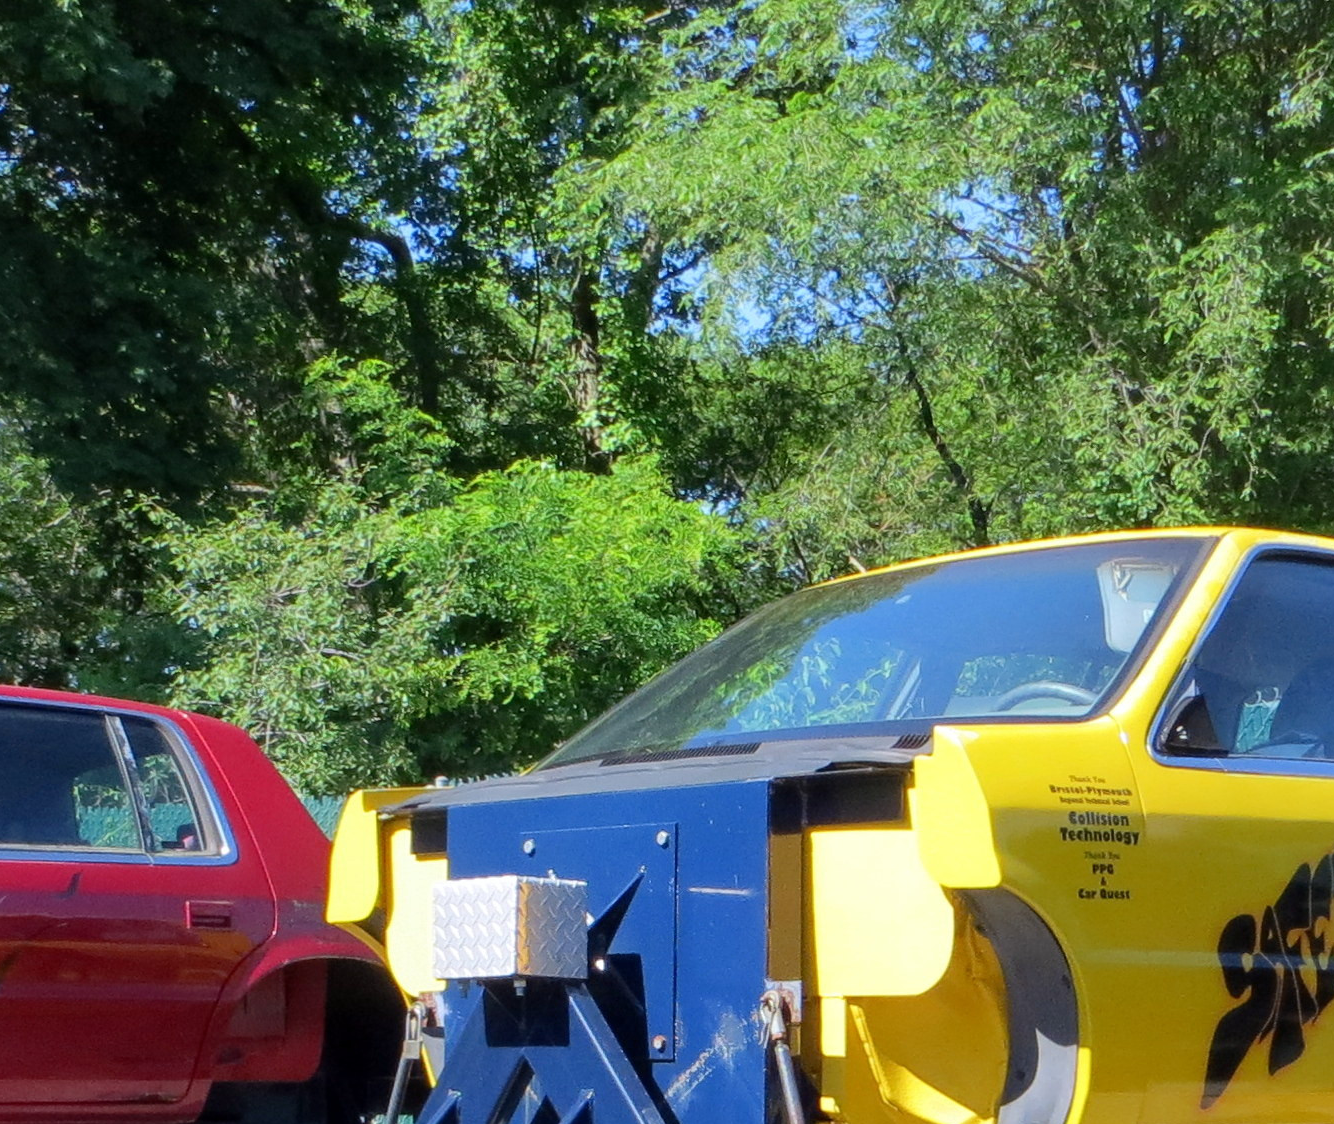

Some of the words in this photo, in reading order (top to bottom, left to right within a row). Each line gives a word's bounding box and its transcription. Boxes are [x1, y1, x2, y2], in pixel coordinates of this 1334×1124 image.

[1049, 785, 1133, 796] Bristol-Plymouth
[1068, 811, 1130, 827] Collision
[1060, 827, 1140, 845] Technology
[1092, 864, 1114, 875] PPG
[1100, 876, 1107, 886] &
[1078, 888, 1097, 899] Car
[1100, 888, 1130, 899] Quest
